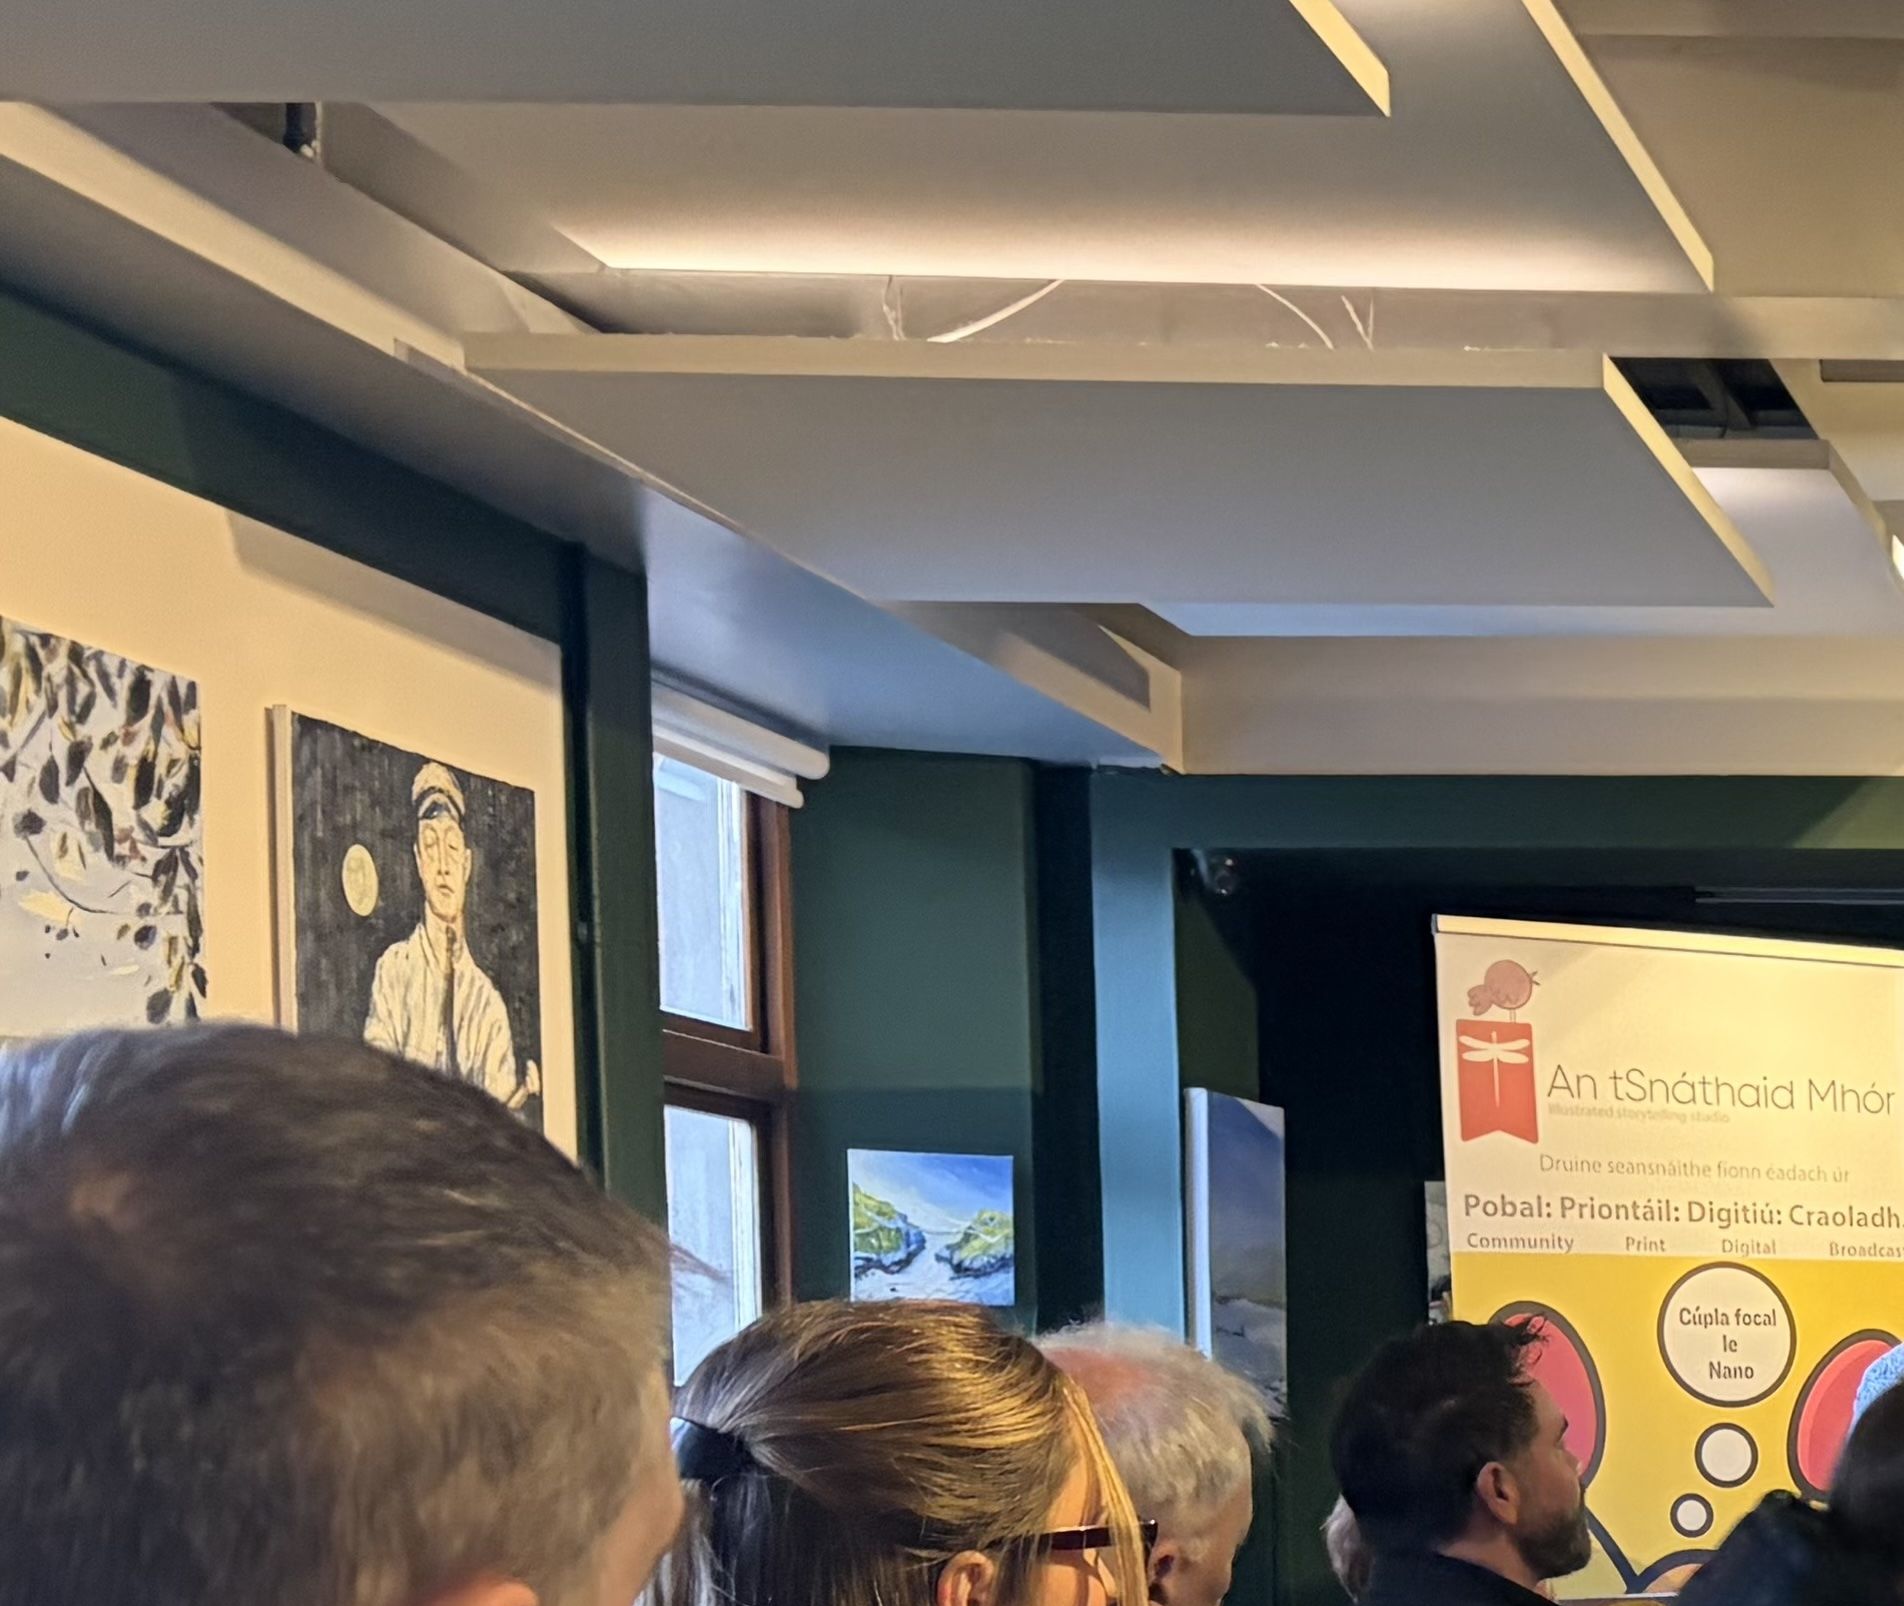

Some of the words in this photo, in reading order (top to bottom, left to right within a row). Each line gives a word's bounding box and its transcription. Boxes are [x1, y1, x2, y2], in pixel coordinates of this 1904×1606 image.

[1547, 1064, 1598, 1100] An
[1609, 1067, 1795, 1111] tSnáthaid
[1807, 1078, 1896, 1116] Mhór
[1540, 1154, 1602, 1174] Druine
[1608, 1159, 1712, 1178] seansnáithe
[1717, 1160, 1761, 1179] fionn
[1766, 1163, 1828, 1182] éadach
[1833, 1166, 1851, 1183] úr
[1464, 1193, 1552, 1218] Pobal:
[1560, 1196, 1681, 1222] Priontáil:
[1688, 1200, 1782, 1230] Digitiú:
[1467, 1232, 1575, 1254] Community
[1626, 1236, 1666, 1253] Print
[1722, 1239, 1777, 1258] Digital
[1679, 1305, 1731, 1329] Cúpla
[1734, 1308, 1777, 1327] focal
[1722, 1334, 1738, 1353] le
[1708, 1361, 1755, 1380] Nano
